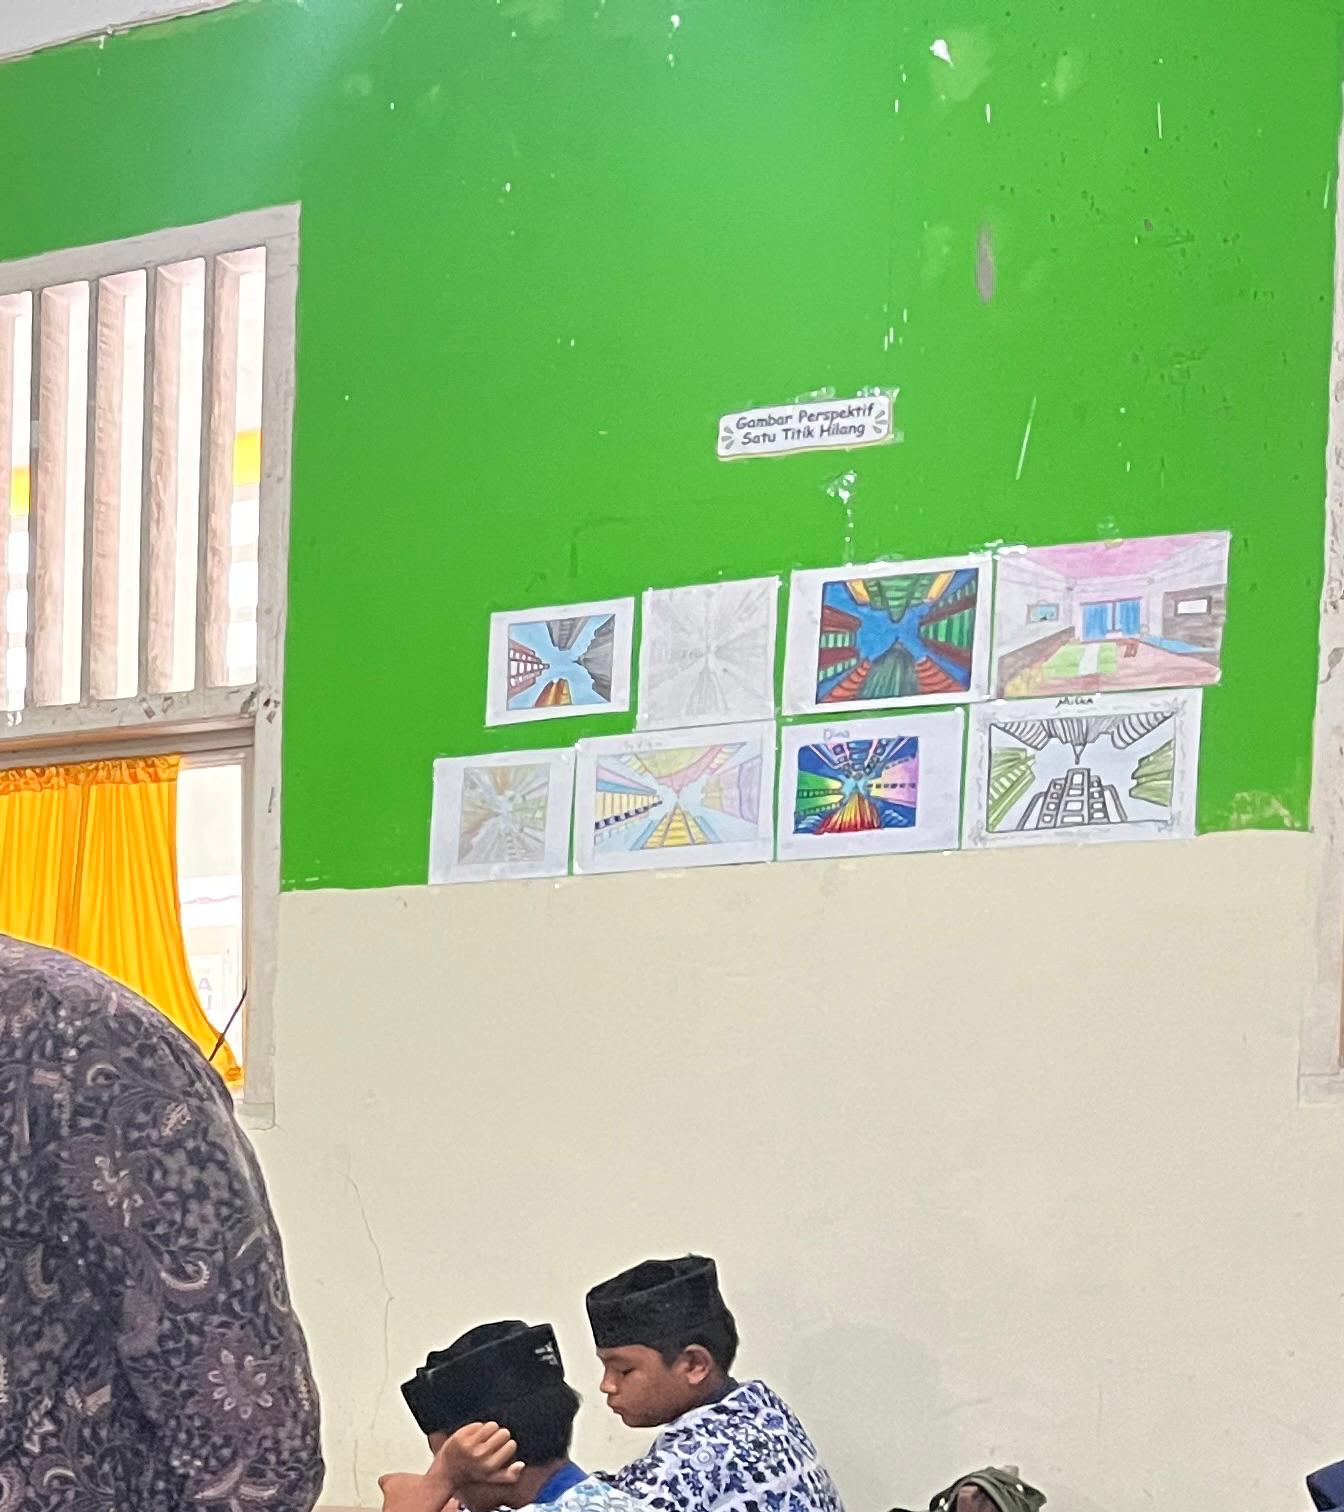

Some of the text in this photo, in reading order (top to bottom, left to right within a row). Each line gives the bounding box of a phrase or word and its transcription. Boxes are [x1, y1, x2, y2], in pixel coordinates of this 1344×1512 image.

[736, 402, 875, 430] Gambar Perspektif
[740, 422, 866, 446] Satu Titik Hilang
